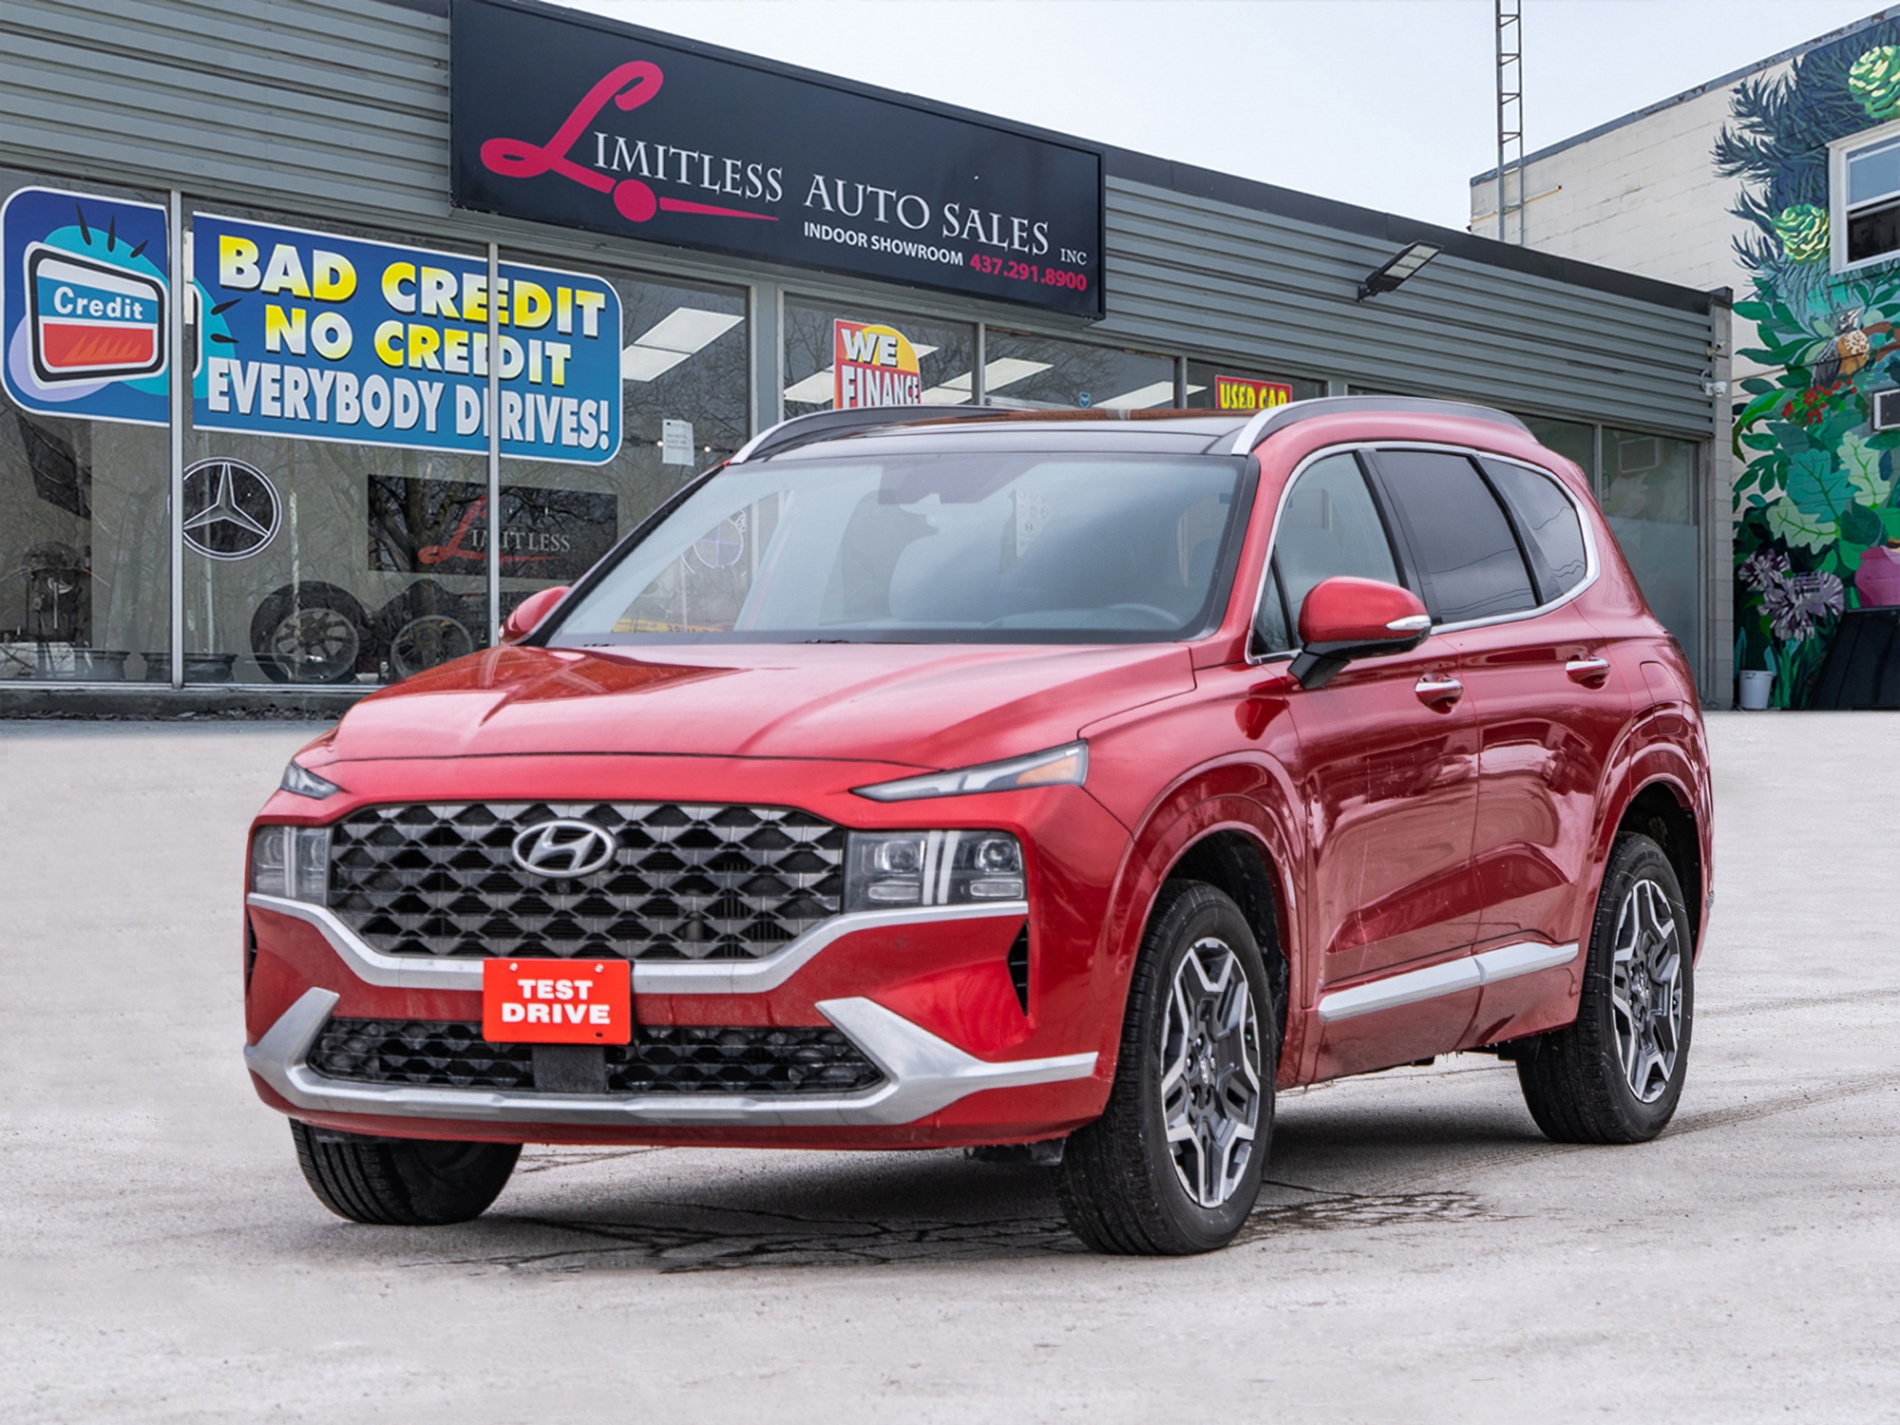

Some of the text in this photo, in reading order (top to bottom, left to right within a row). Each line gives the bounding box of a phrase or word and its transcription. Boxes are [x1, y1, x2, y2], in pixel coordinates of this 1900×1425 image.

[481, 60, 1088, 266] LIMITLESS AUTO SALES INC
[804, 222, 1088, 292] INDOOR SHOWROOM 437.291.8900
[54, 286, 143, 320] Credit
[219, 234, 606, 338] BAD CREDIT
[265, 304, 572, 387] NO CREDIT
[841, 328, 898, 368] WE
[208, 356, 445, 432] EVERYBODY
[456, 384, 611, 451] DRIVES!
[841, 364, 919, 409] FINANCE
[1220, 382, 1256, 410] USED
[517, 979, 593, 1000] TEST
[502, 1003, 611, 1025] DRIVE
